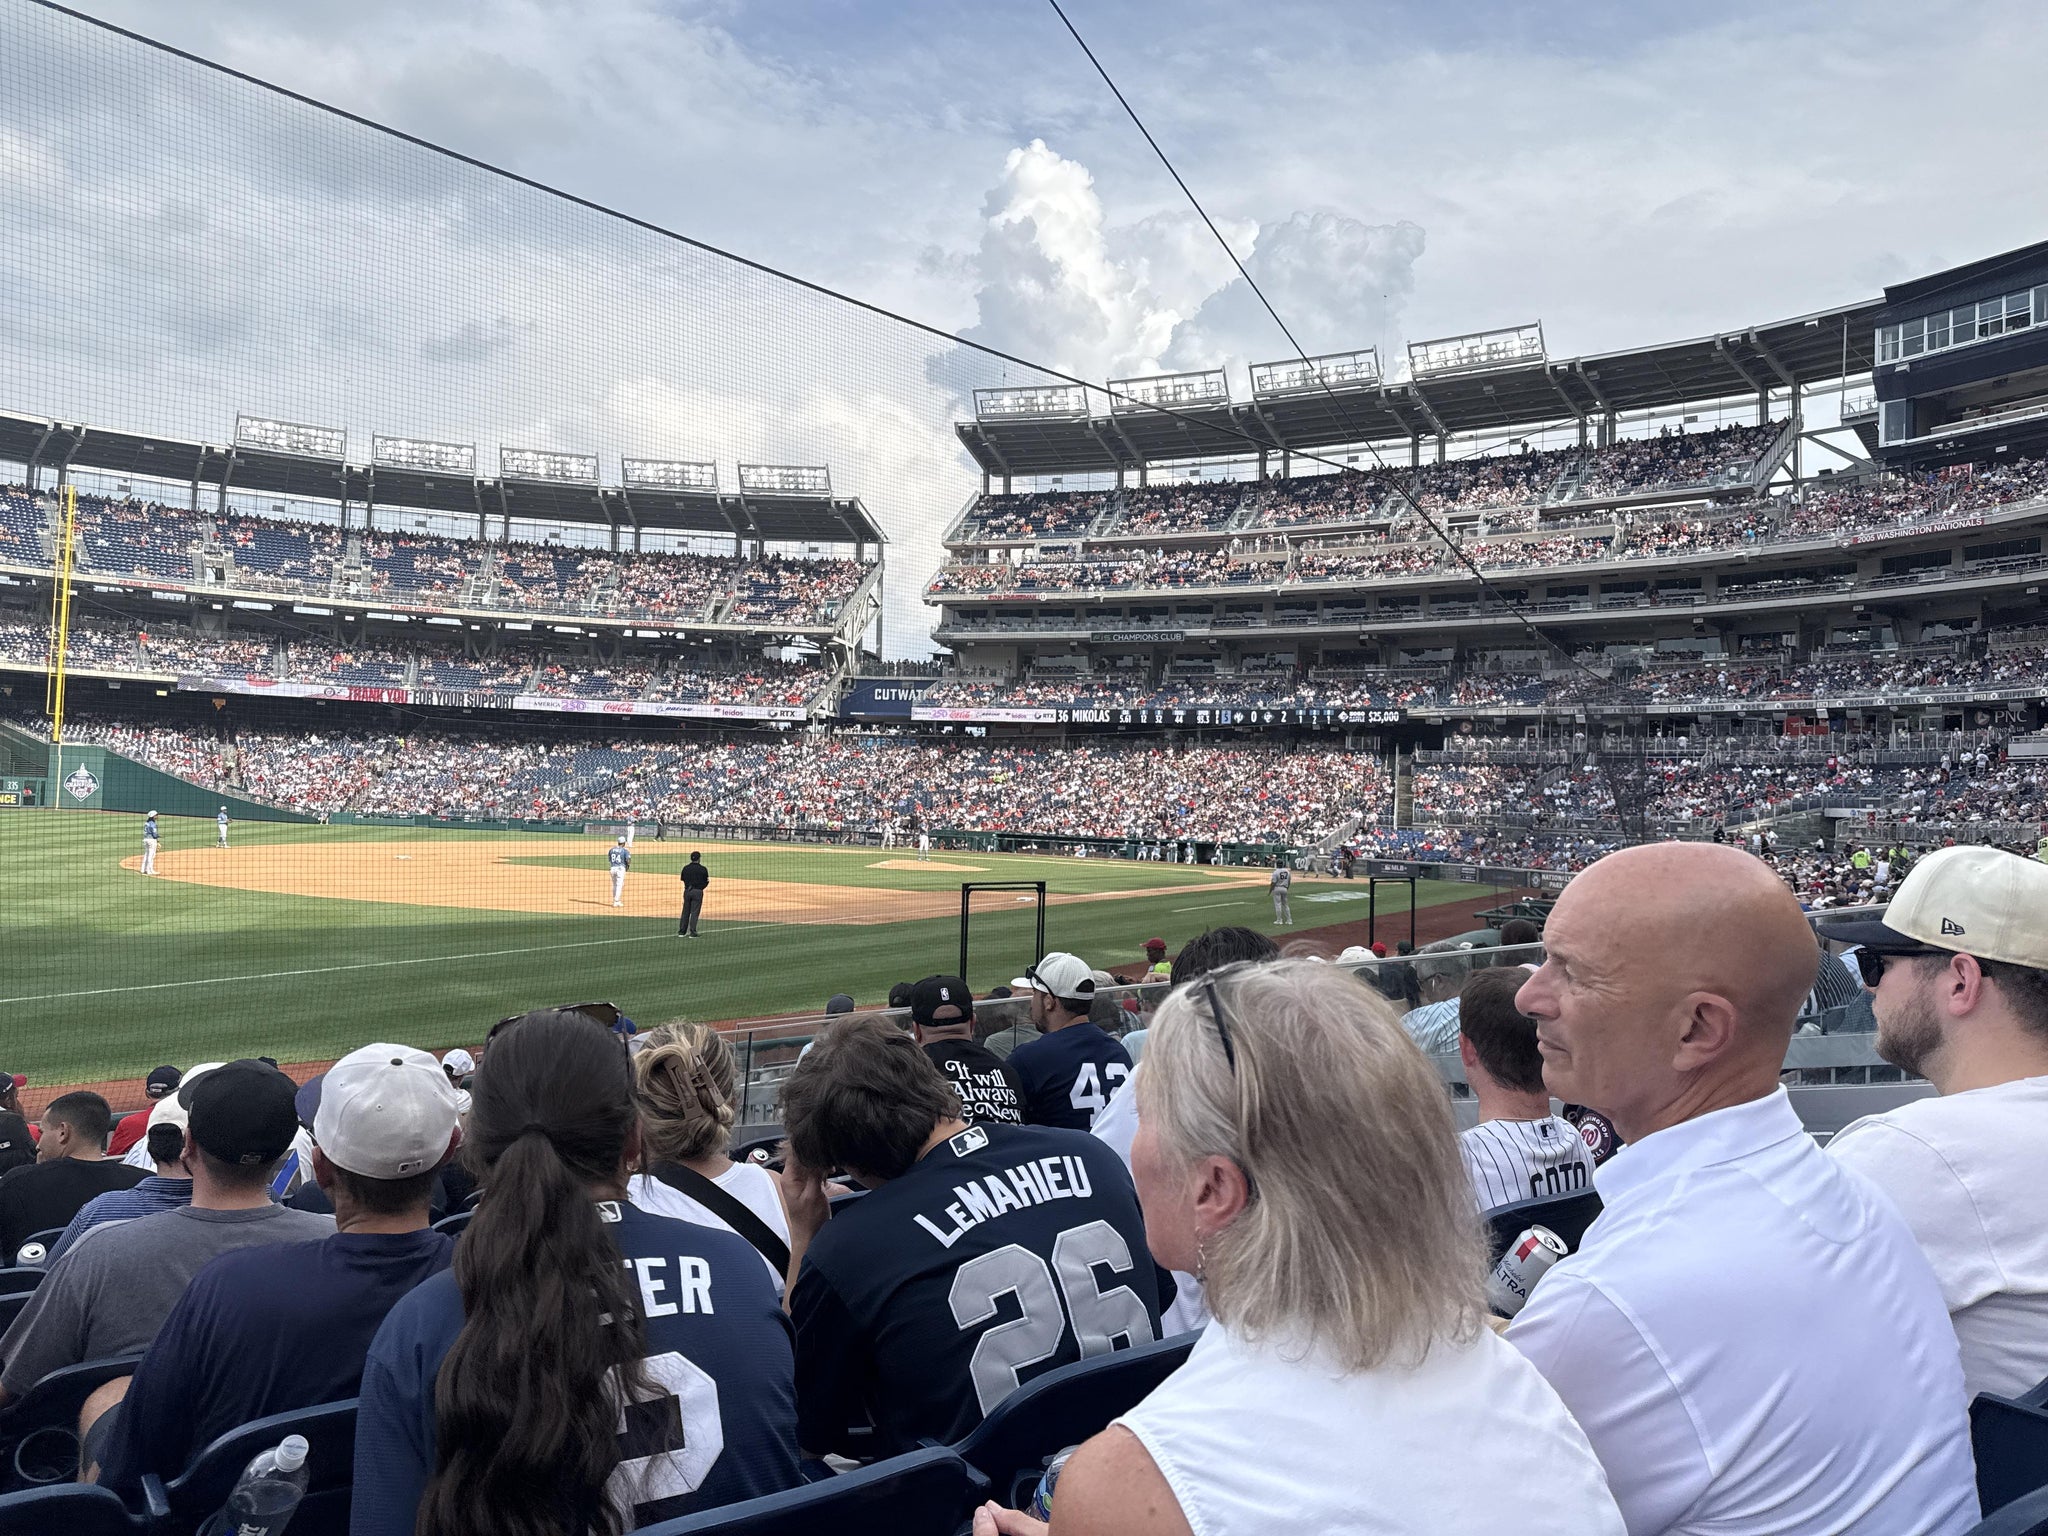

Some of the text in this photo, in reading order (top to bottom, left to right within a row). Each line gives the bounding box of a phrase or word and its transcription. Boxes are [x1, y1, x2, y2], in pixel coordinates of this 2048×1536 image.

[1857, 518, 1982, 544] 2005 WASHINGTON NATIONALS
[1112, 633, 1158, 641] CHAMPIONS
[346, 686, 515, 709] THANK YOU FOR YOUR SUPPORT
[1934, 695, 1966, 703] GOSLIN
[722, 708, 744, 717] leidos
[779, 710, 796, 718] RTX
[1057, 709, 1110, 723] 36 MIKOLAS
[1119, 714, 1132, 724] 5.61
[1174, 714, 1183, 724] 44
[1197, 714, 1210, 724] 93.3
[1250, 710, 1257, 723] 0
[1280, 710, 1287, 723] 2
[1368, 710, 1400, 724] $25,000
[1994, 710, 2027, 723] PNC
[1475, 721, 1503, 733] PNC
[7, 781, 18, 790] 335
[611, 853, 621, 863] 84
[1541, 873, 1572, 882] NATIONALS
[1549, 881, 1563, 889] PARK
[945, 1060, 973, 1080] It
[973, 1068, 1007, 1088] will
[948, 1081, 1018, 1105] Always
[974, 1102, 1022, 1123] New
[913, 1155, 1093, 1249] LeMAHIEU
[948, 1219, 1155, 1419] 26
